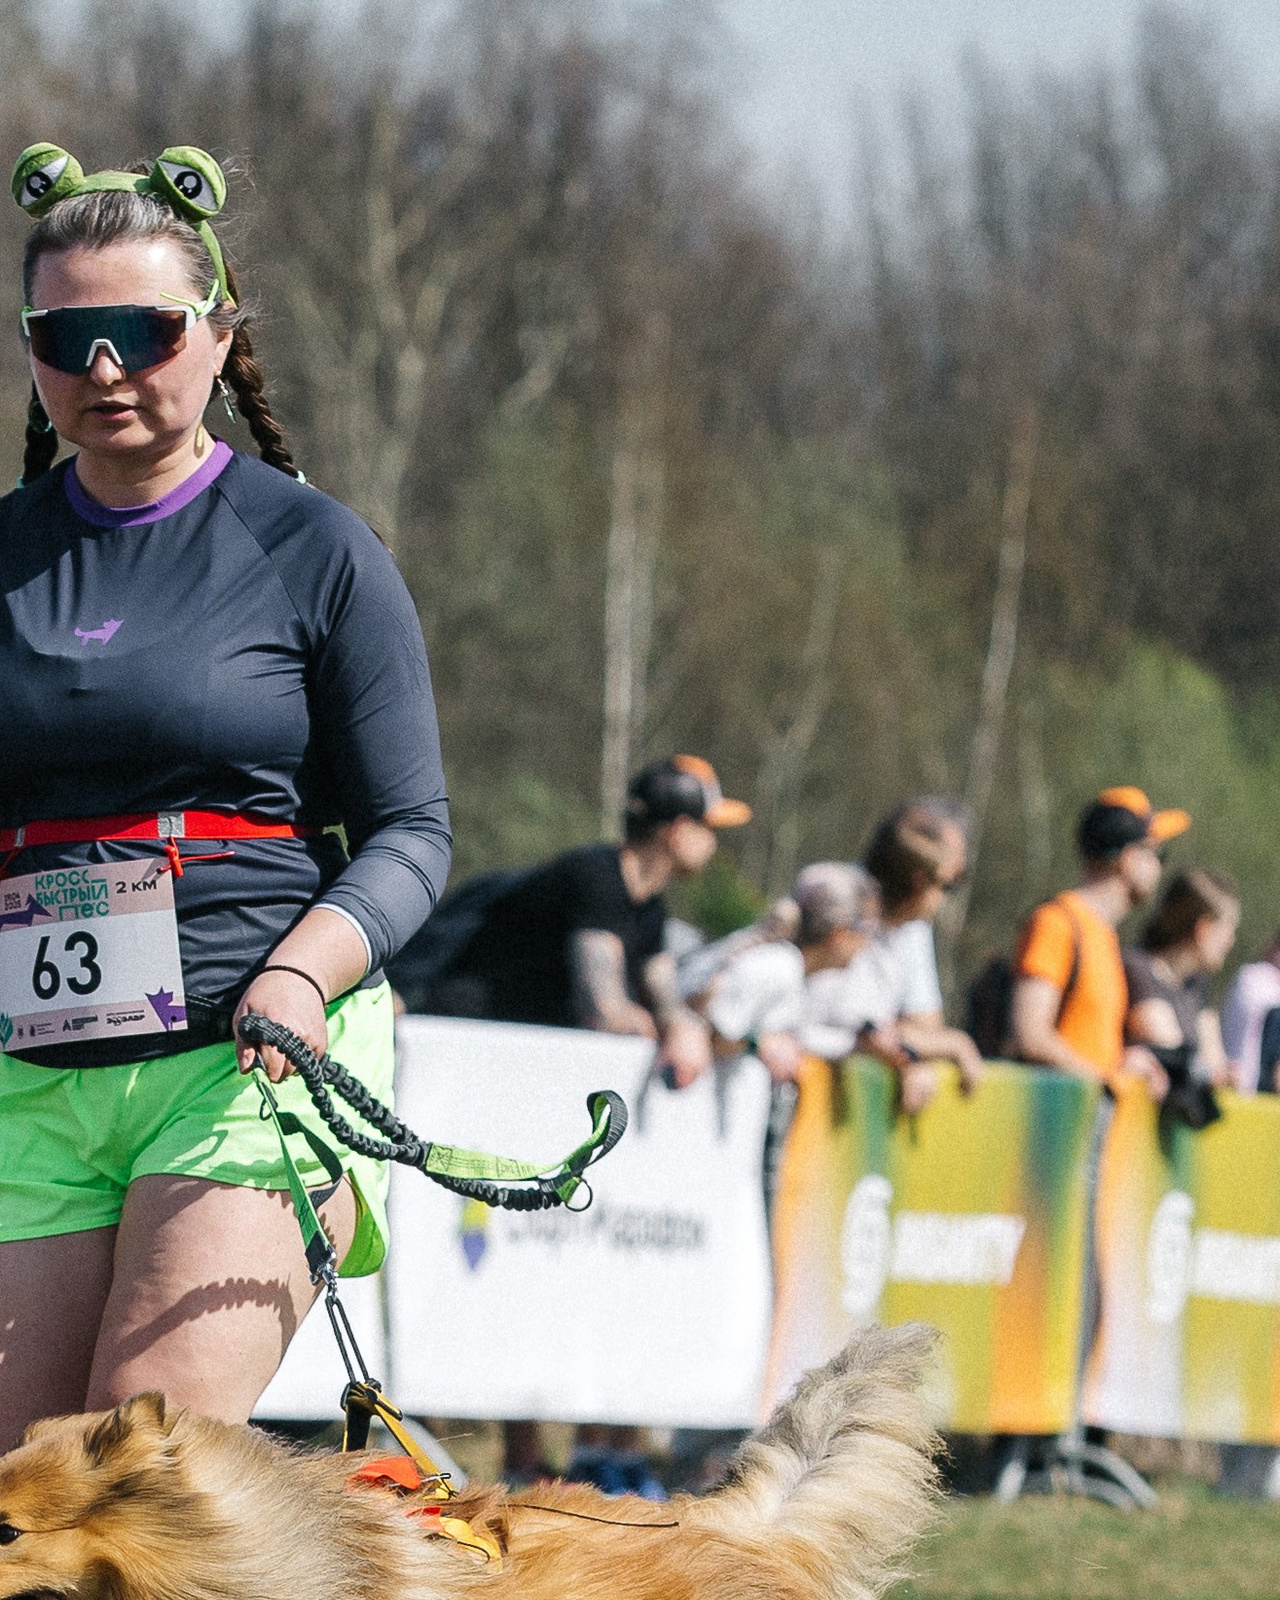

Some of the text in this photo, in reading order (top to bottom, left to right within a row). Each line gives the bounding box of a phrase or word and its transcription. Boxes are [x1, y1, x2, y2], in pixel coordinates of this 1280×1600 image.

[34, 869, 89, 891] КРОСС
[115, 881, 127, 895] 2
[32, 931, 102, 1000] 63
